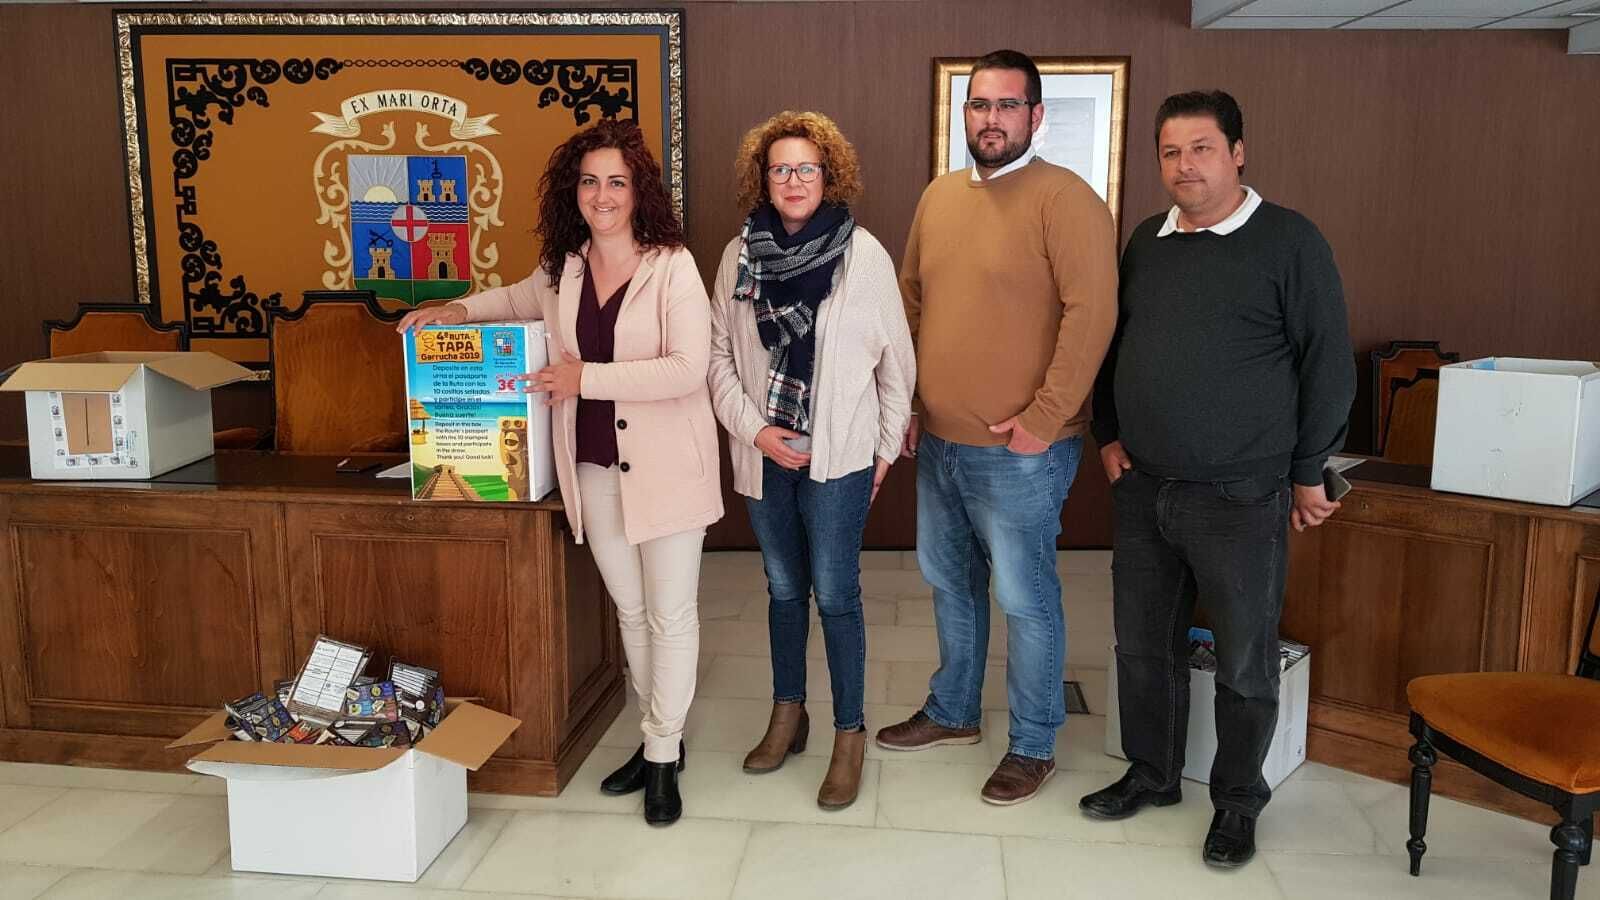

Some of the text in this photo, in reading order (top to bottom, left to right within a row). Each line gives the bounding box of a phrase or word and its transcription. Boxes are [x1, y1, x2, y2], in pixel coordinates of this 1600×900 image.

[351, 93, 457, 116] EX MARI ORTA
[437, 341, 475, 352] TAPA
[421, 352, 480, 361] Garrucha 2019
[498, 379, 515, 391] 3€
